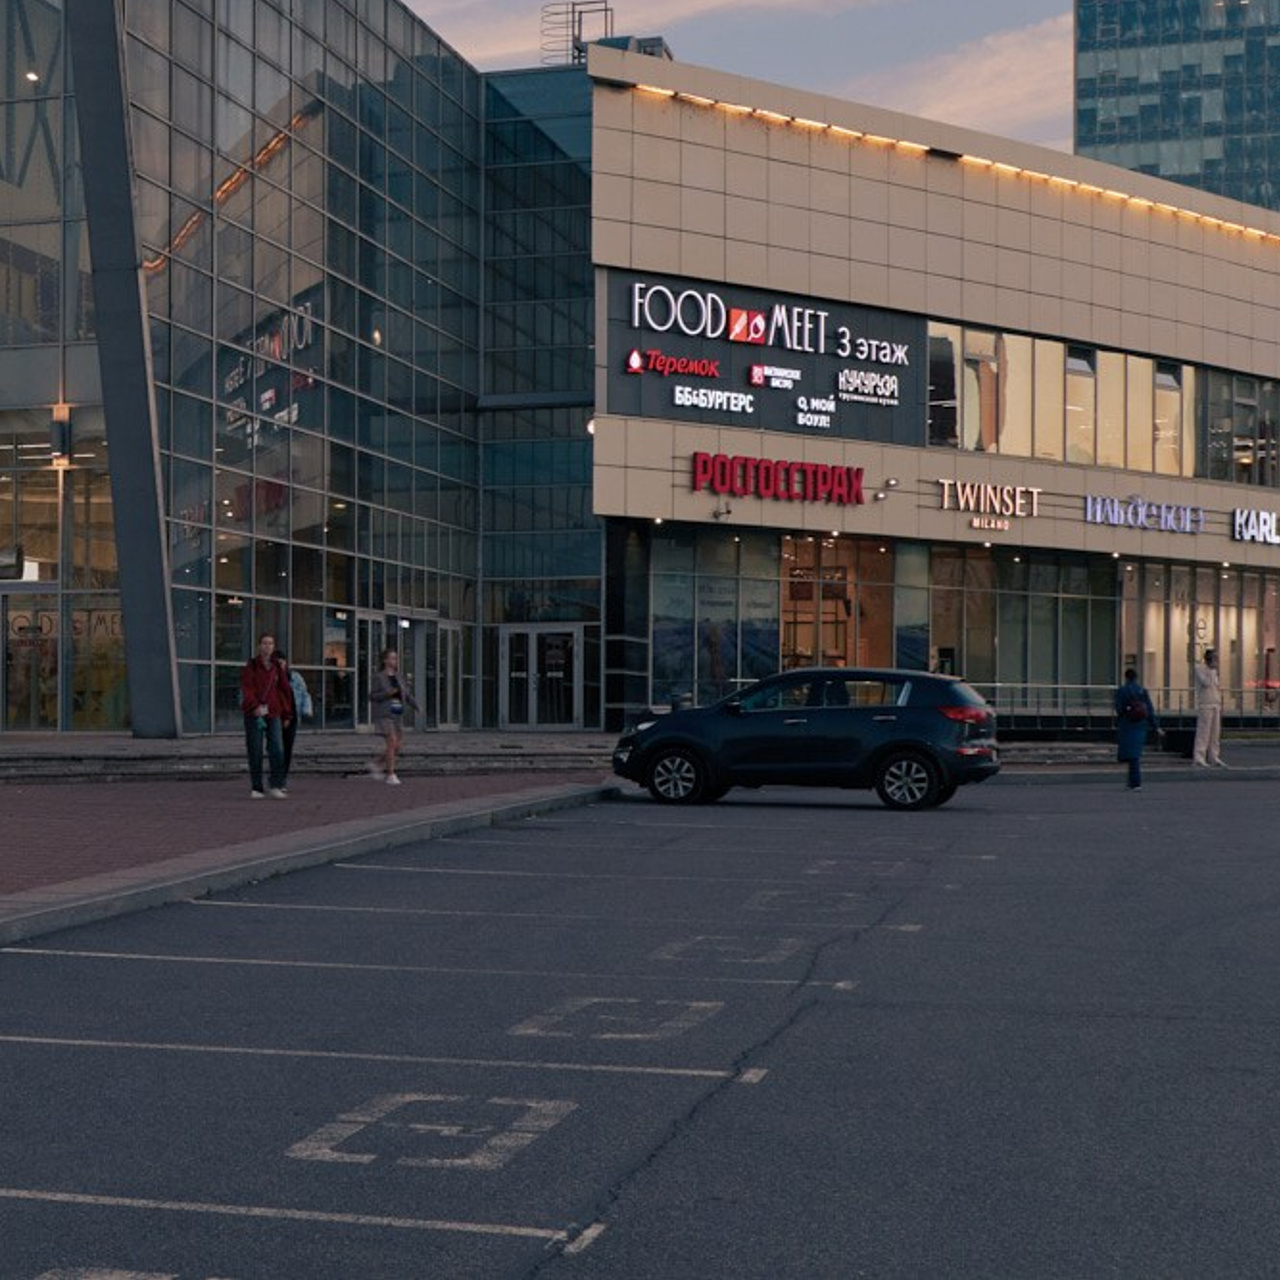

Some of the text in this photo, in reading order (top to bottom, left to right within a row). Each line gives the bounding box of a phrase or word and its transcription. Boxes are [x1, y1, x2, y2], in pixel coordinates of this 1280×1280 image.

[632, 283, 910, 365] FOOD MEET 3 этаж
[645, 349, 720, 378] Теремок
[811, 395, 836, 412] МОЙ
[692, 451, 865, 505] РОСГОССТРАХ
[938, 478, 1043, 517] TWINSET
[972, 517, 1010, 531] MILANO
[1235, 507, 1280, 544] KARL
